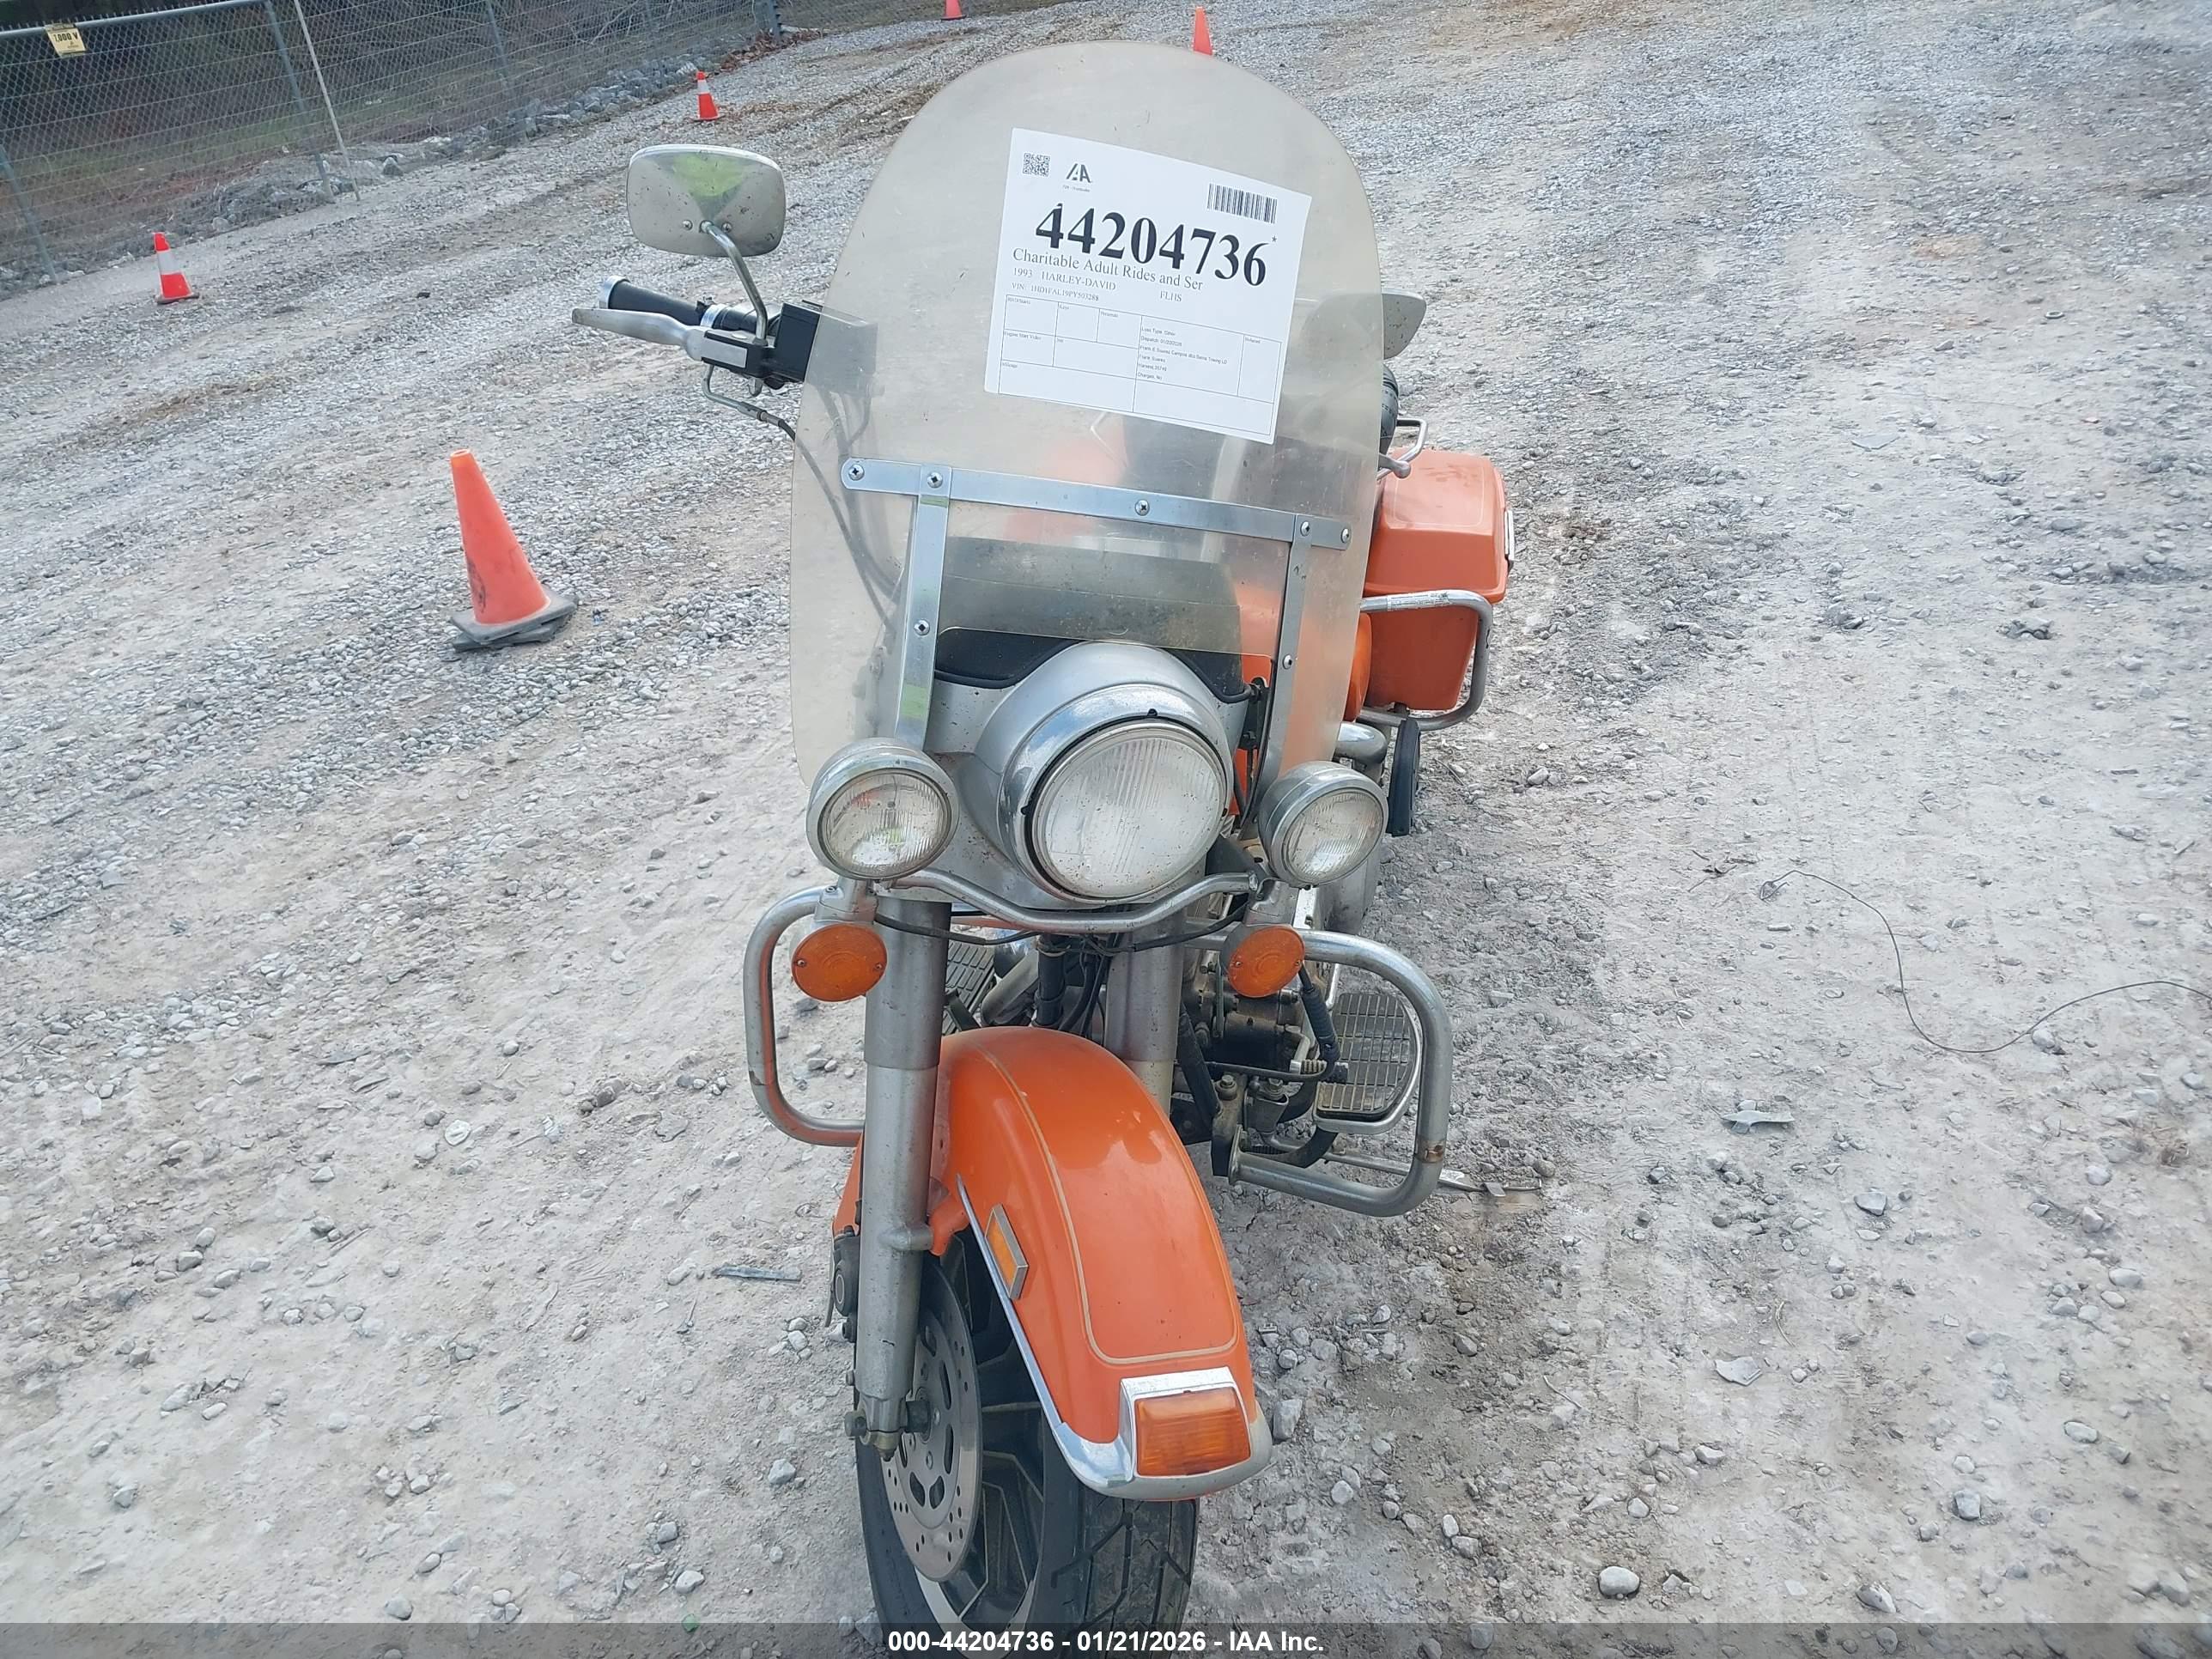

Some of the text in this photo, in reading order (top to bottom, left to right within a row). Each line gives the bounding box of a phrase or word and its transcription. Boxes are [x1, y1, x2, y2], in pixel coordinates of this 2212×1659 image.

[1012, 247, 1203, 291] Charitable Adult Rides and Ser
[1012, 267, 1033, 278] 1993
[1041, 270, 1116, 290] HARLEY-DAVID
